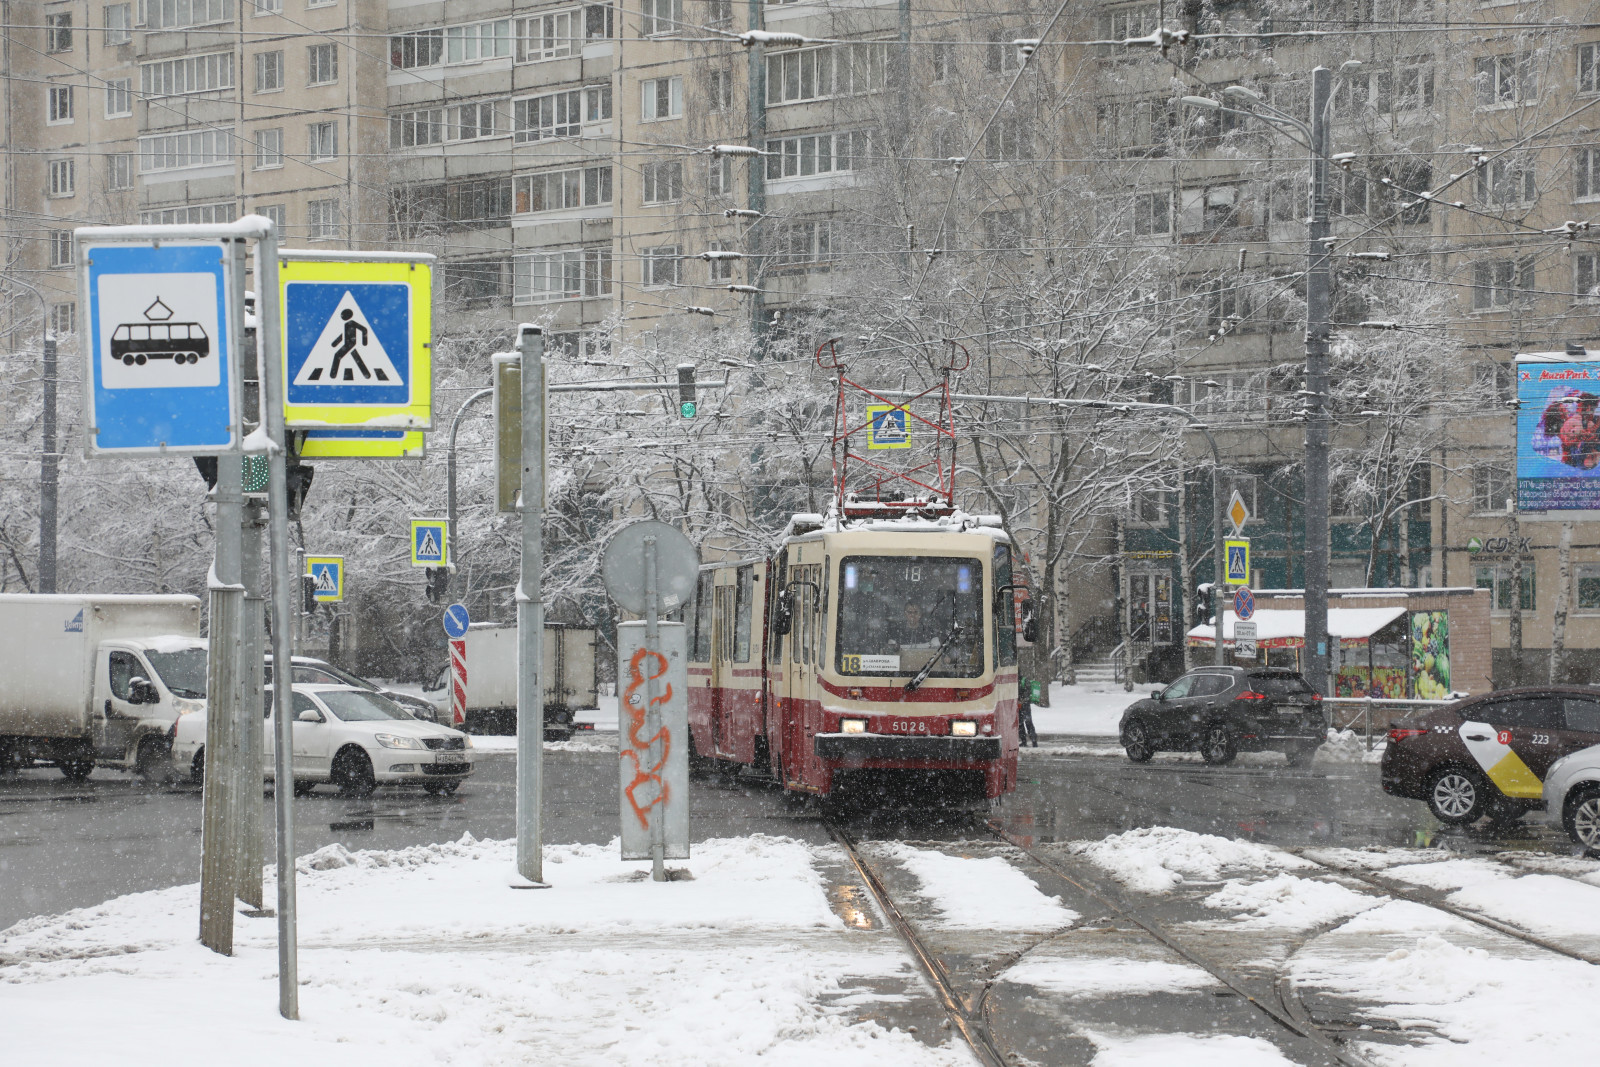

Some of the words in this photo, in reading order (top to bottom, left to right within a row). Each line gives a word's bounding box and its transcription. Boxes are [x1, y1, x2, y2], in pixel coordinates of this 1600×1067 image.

[905, 566, 921, 582] 18
[843, 657, 861, 671] 18
[892, 721, 925, 732] 5028
[1500, 732, 1508, 742] Я
[1531, 734, 1549, 745] 223
